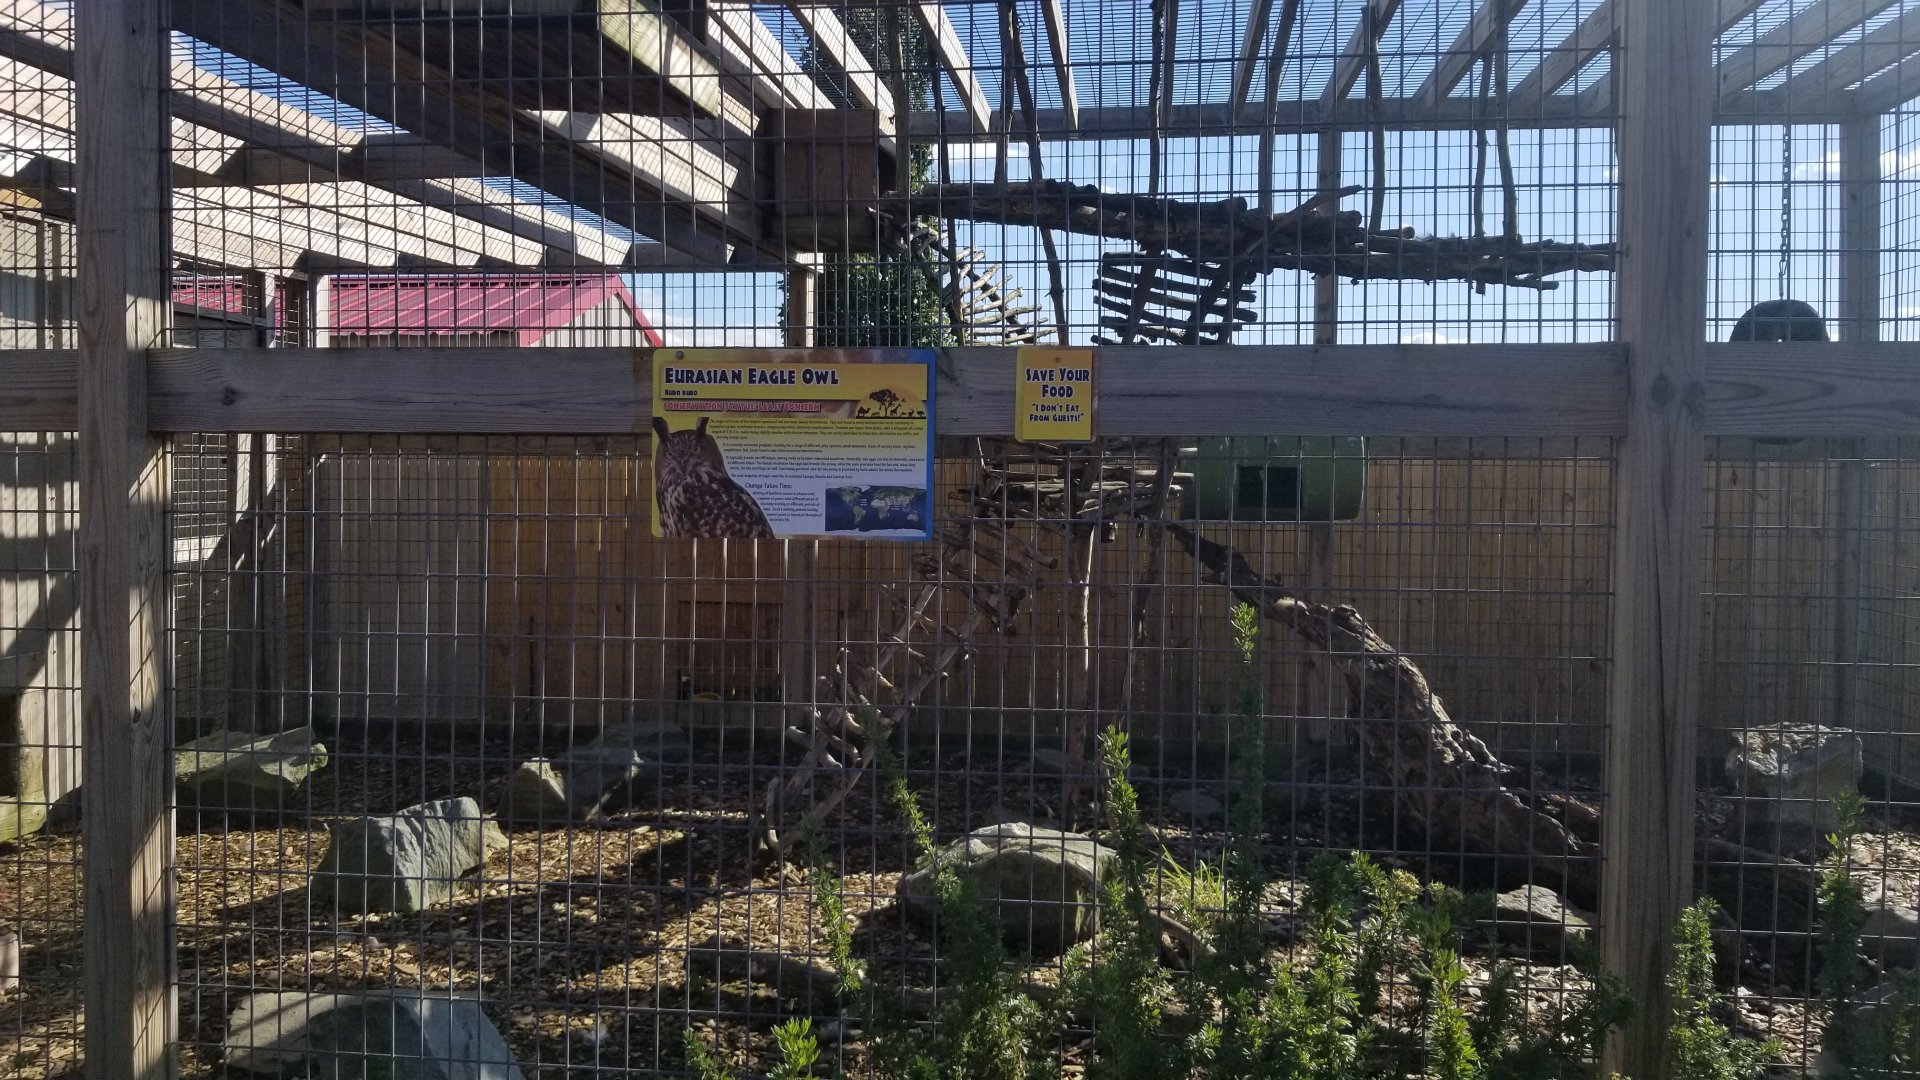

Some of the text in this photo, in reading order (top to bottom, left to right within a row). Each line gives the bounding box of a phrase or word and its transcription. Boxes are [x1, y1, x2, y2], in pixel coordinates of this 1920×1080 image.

[664, 367, 839, 385] EURASIAN EAGLE OWL
[1025, 368, 1090, 382] SAVE YOUR
[1041, 384, 1074, 398] FOOD
[664, 401, 724, 412] CONSERVATION
[757, 402, 784, 413] LEAST
[784, 402, 822, 413] CONCERN
[1041, 403, 1063, 412] DON'T
[1066, 404, 1080, 412] EAT
[1029, 414, 1050, 422] FROM
[744, 482, 763, 490] Change
